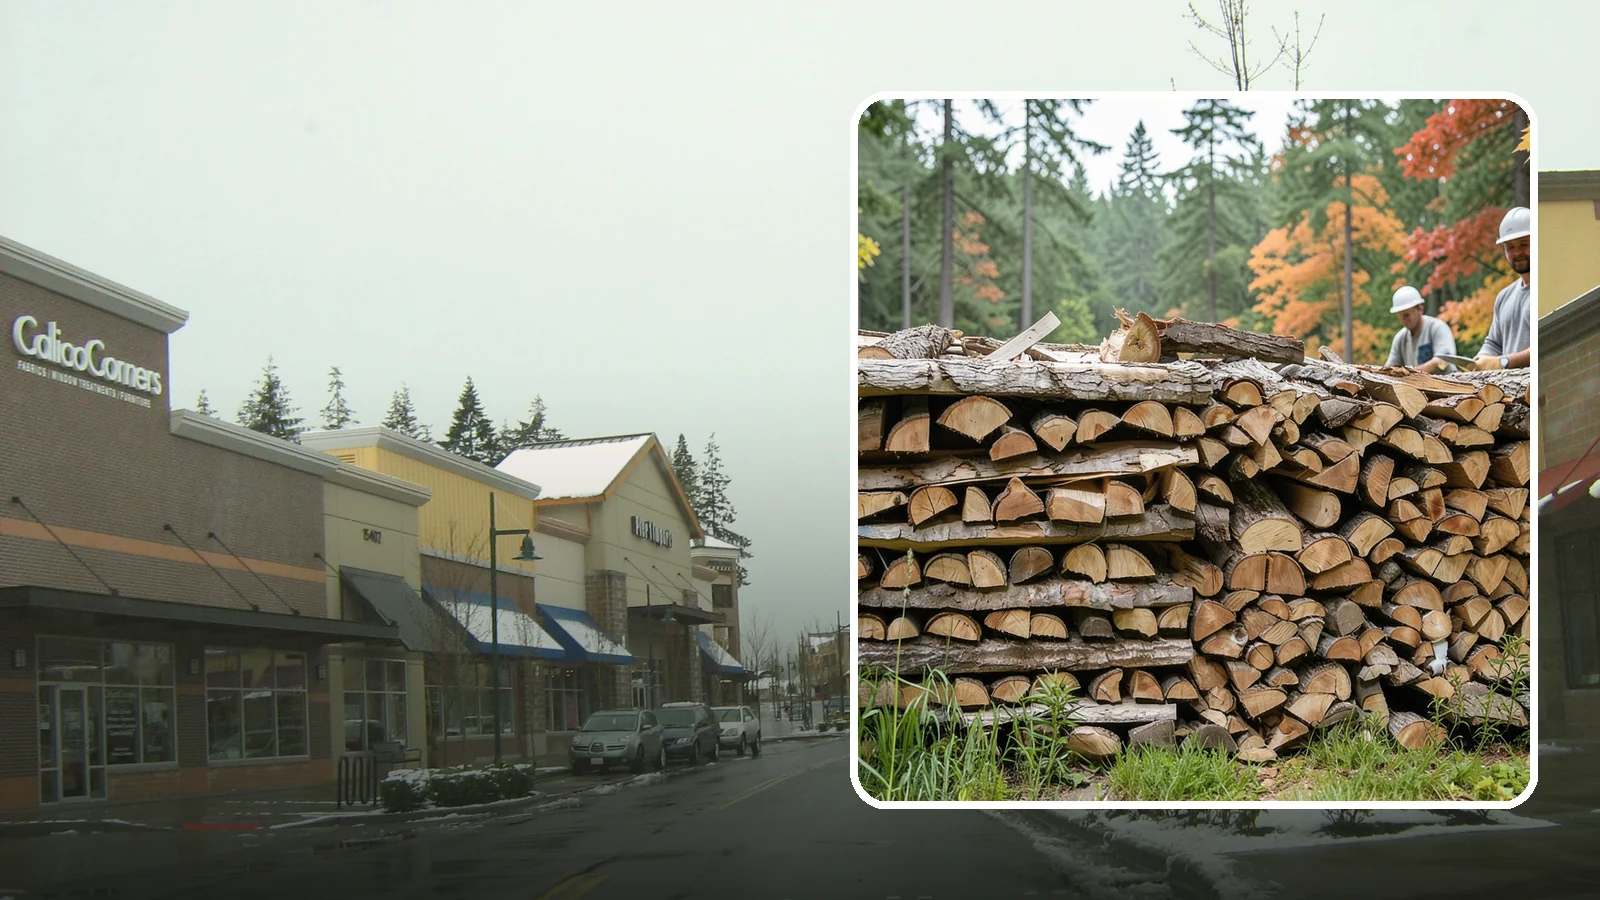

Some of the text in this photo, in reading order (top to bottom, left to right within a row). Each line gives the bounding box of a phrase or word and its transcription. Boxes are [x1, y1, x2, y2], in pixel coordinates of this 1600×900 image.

[16, 359, 151, 409] FABRICS WINDOW TREATMENTS FURNITURE
